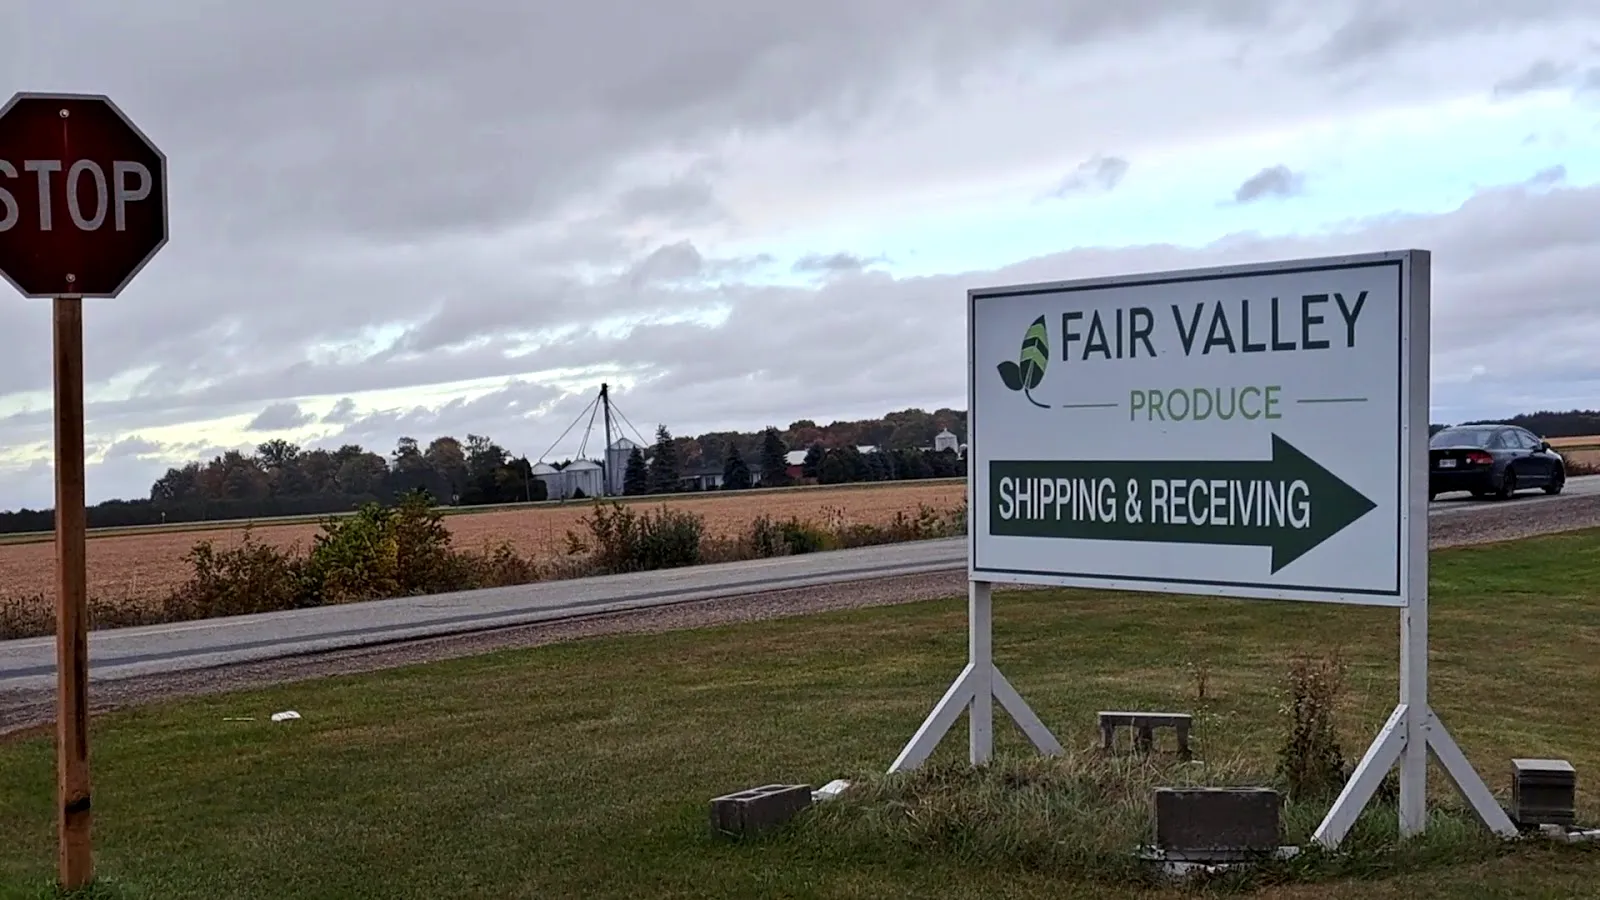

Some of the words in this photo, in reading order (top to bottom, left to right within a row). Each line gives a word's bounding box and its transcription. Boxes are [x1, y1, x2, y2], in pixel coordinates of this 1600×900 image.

[1061, 307, 1157, 362] FAIR
[1171, 290, 1369, 357] VALLEY
[1130, 385, 1282, 421] PRODUCE
[998, 475, 1117, 523] SHIPPING
[1126, 478, 1144, 524] &
[1150, 478, 1311, 529] RECEIVING
